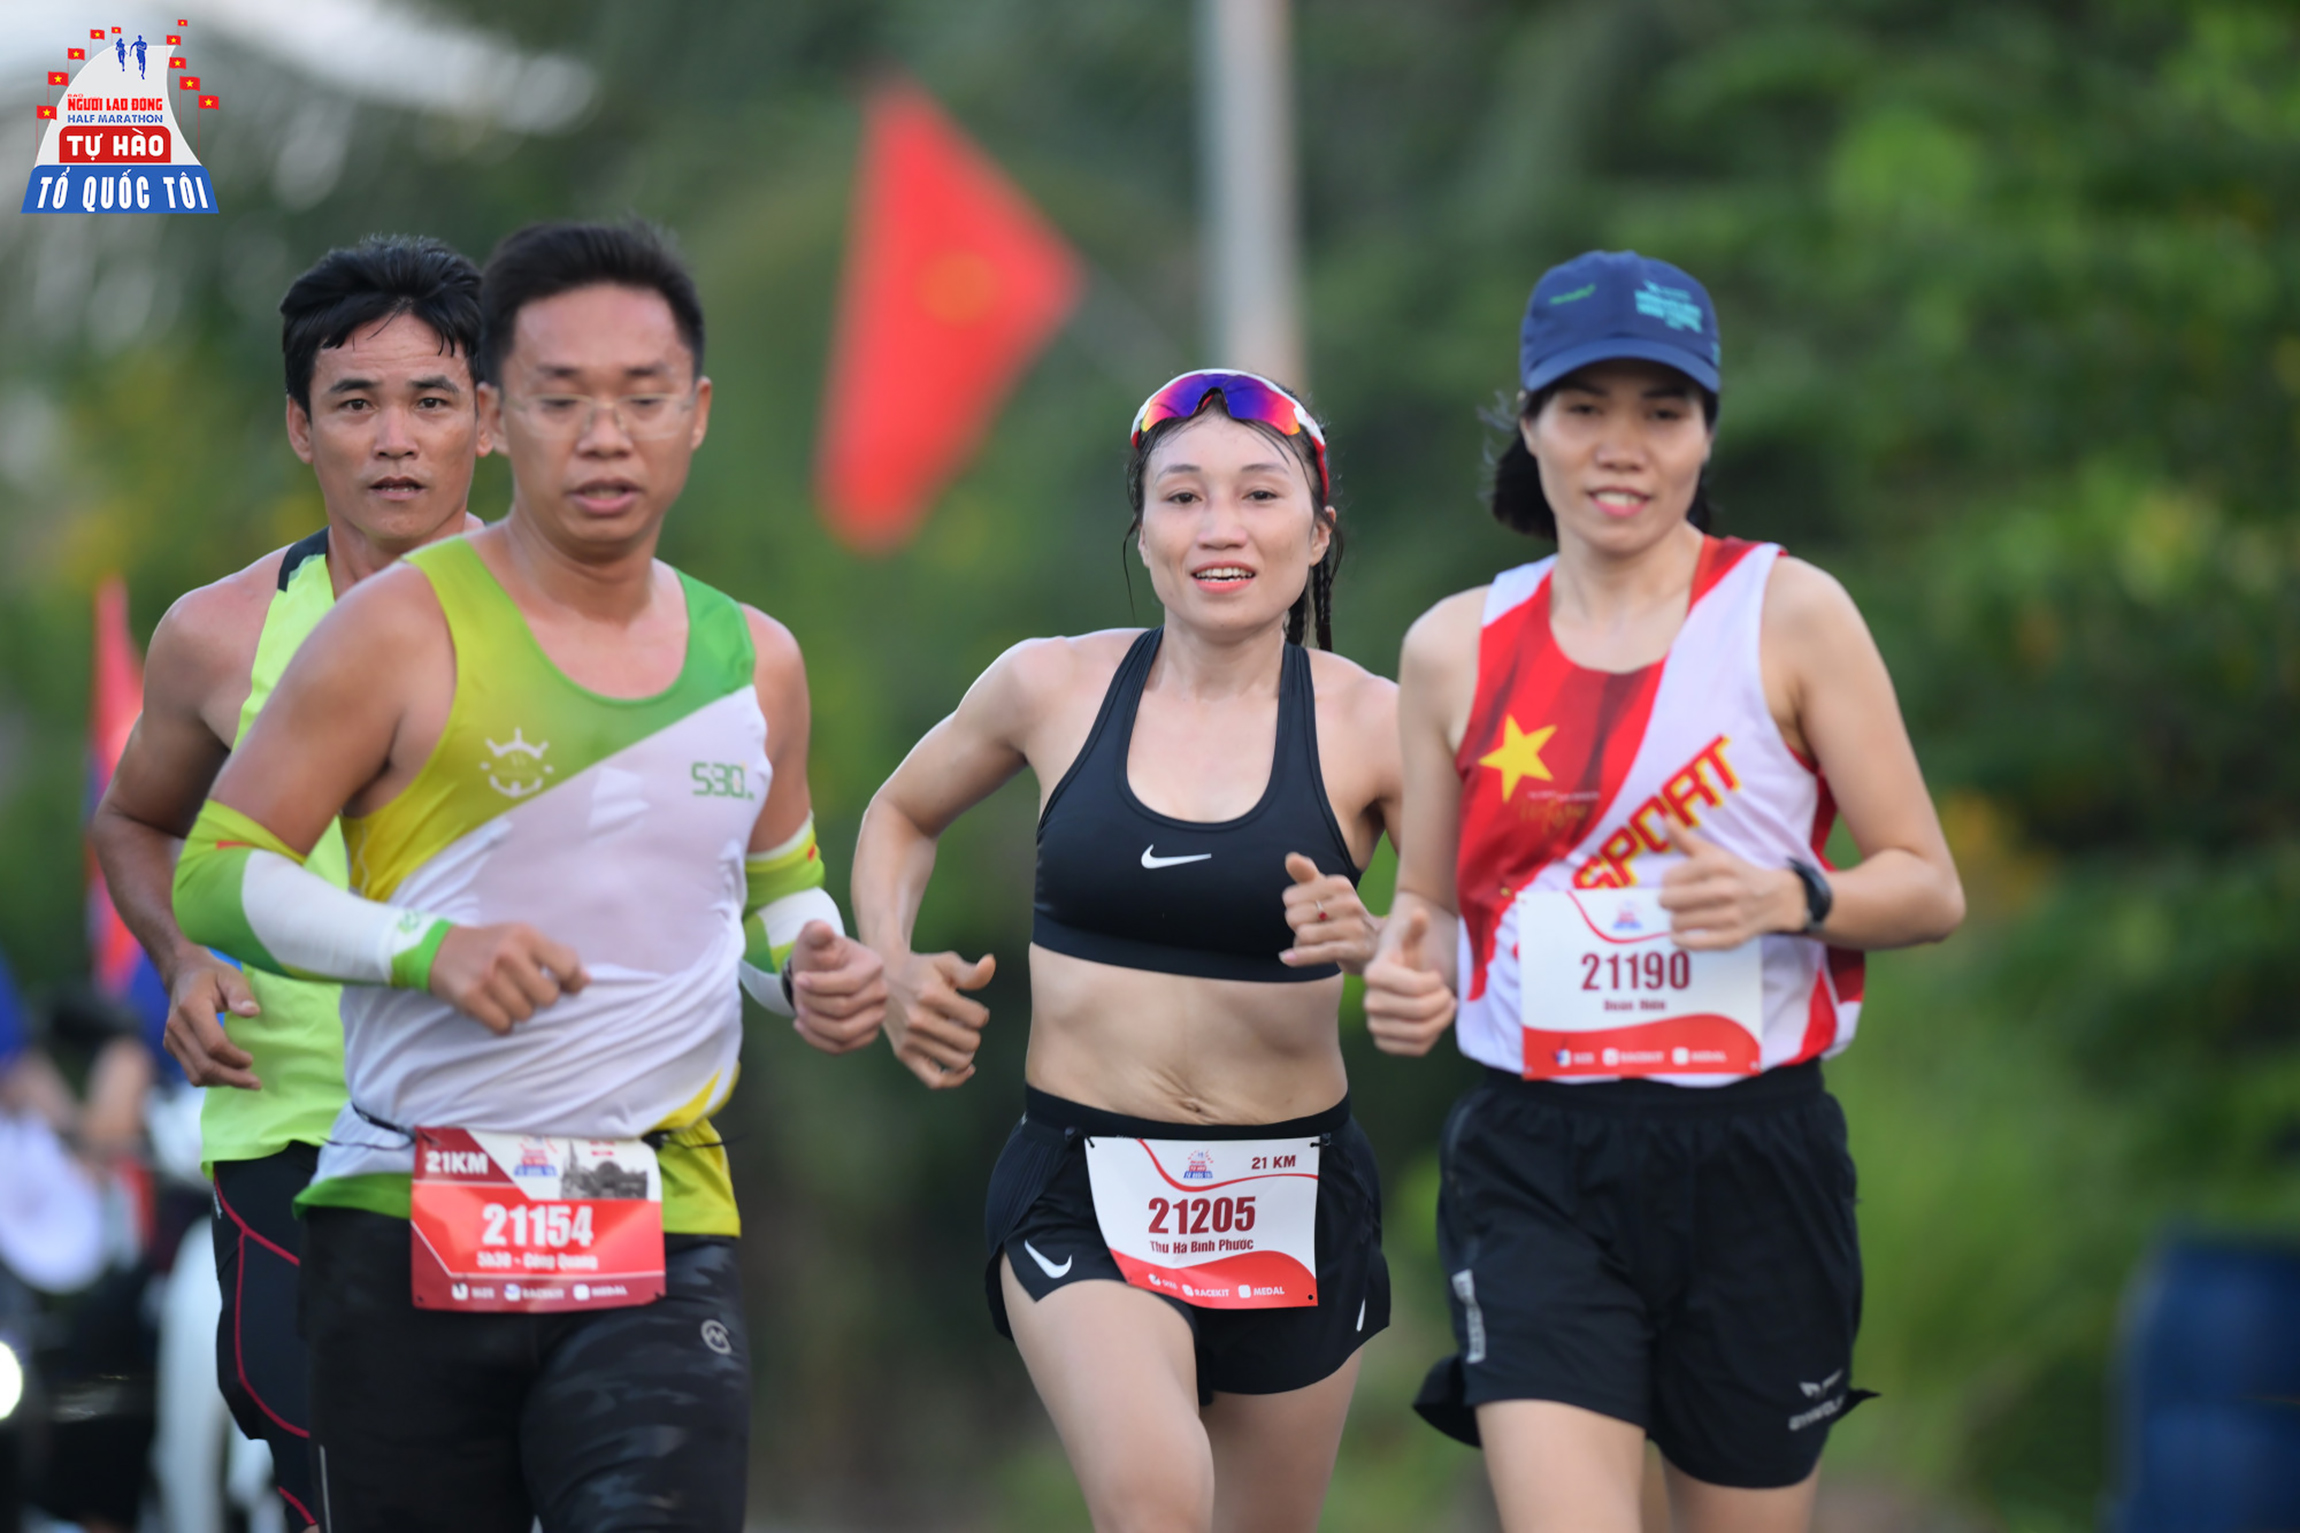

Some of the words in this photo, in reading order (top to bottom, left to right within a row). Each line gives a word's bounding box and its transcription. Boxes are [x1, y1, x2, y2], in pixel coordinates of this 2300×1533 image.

[1581, 950, 1691, 991] 21190
[425, 1151, 489, 1175] 21KM
[1251, 1157, 1267, 1170] 21
[1273, 1155, 1296, 1169] KM
[482, 1203, 594, 1247] 21154
[1148, 1196, 1256, 1234] 21205
[1194, 1288, 1229, 1297] RACEKIT
[1253, 1286, 1285, 1296] MEDAL
